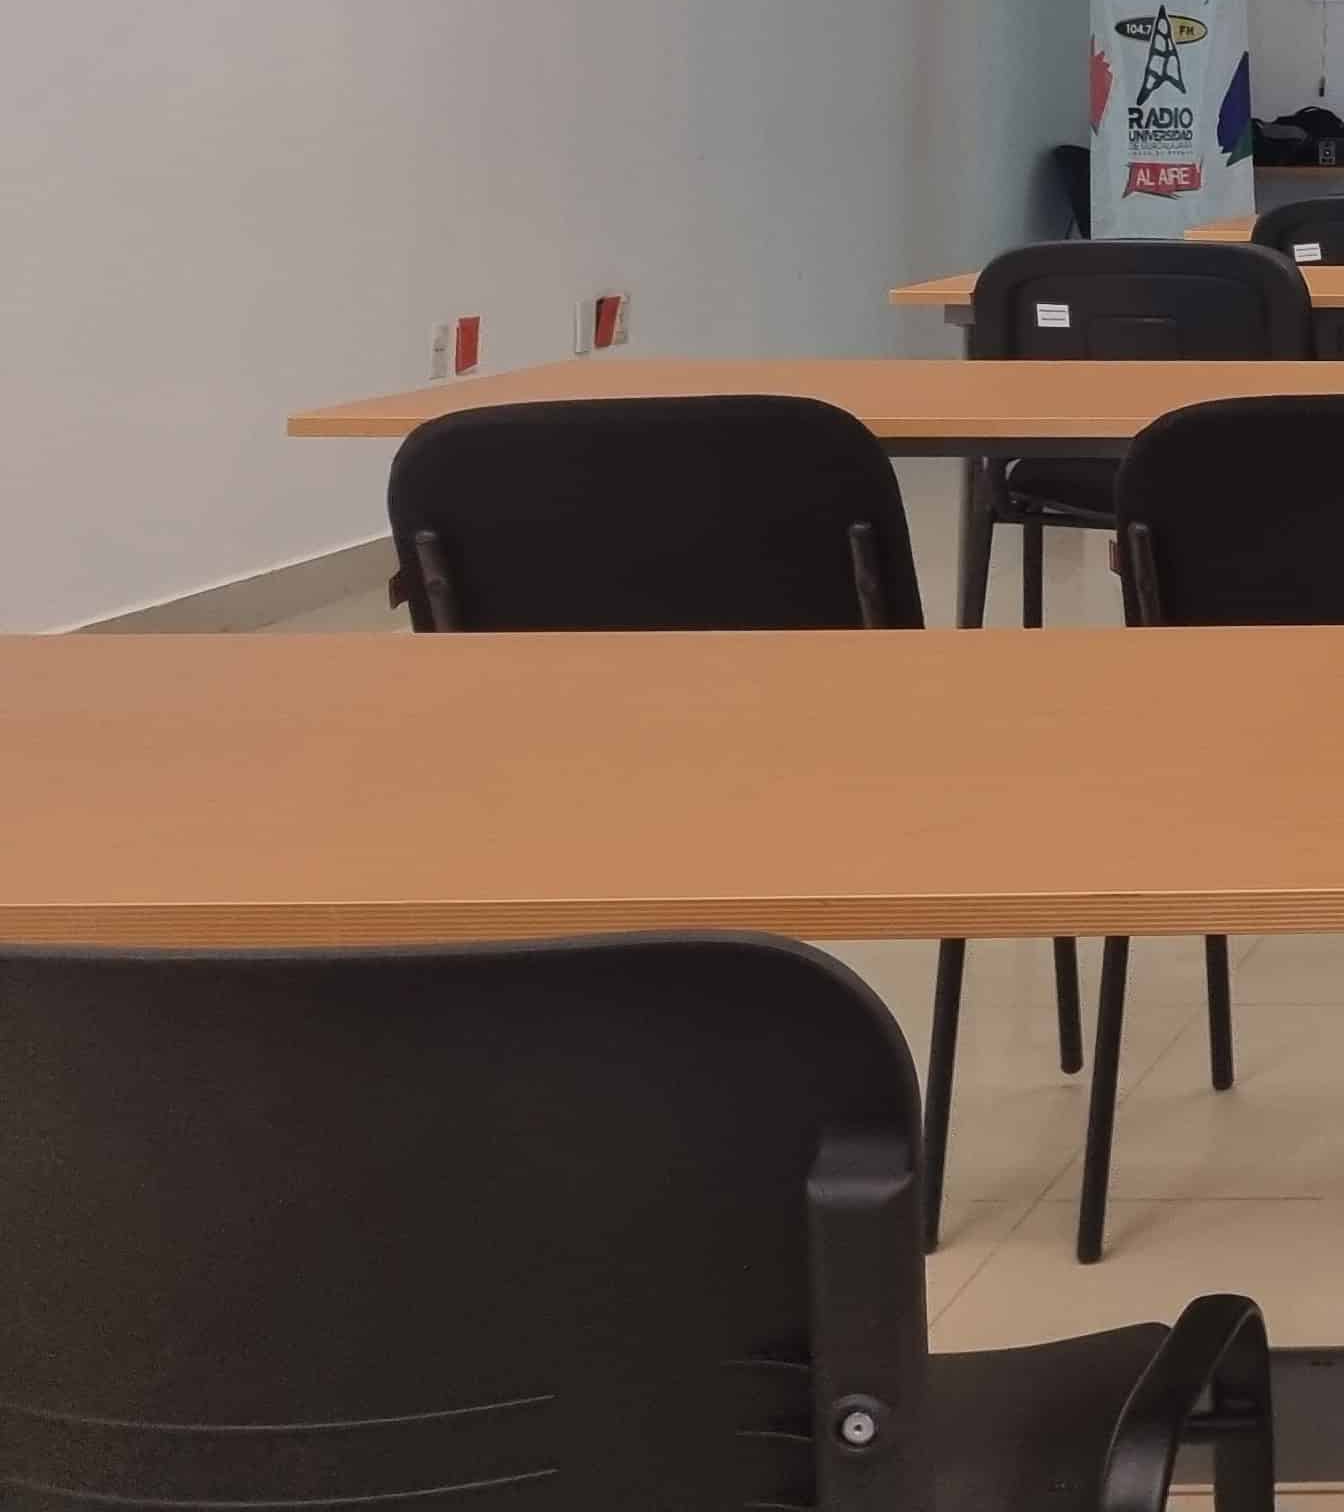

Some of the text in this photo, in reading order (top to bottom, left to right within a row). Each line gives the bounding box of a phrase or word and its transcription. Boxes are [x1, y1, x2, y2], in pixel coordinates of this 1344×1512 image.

[1128, 107, 1193, 129] RADIO
[1128, 129, 1193, 142] UNIVERSIDAD
[1136, 167, 1191, 186] AL AIRE
